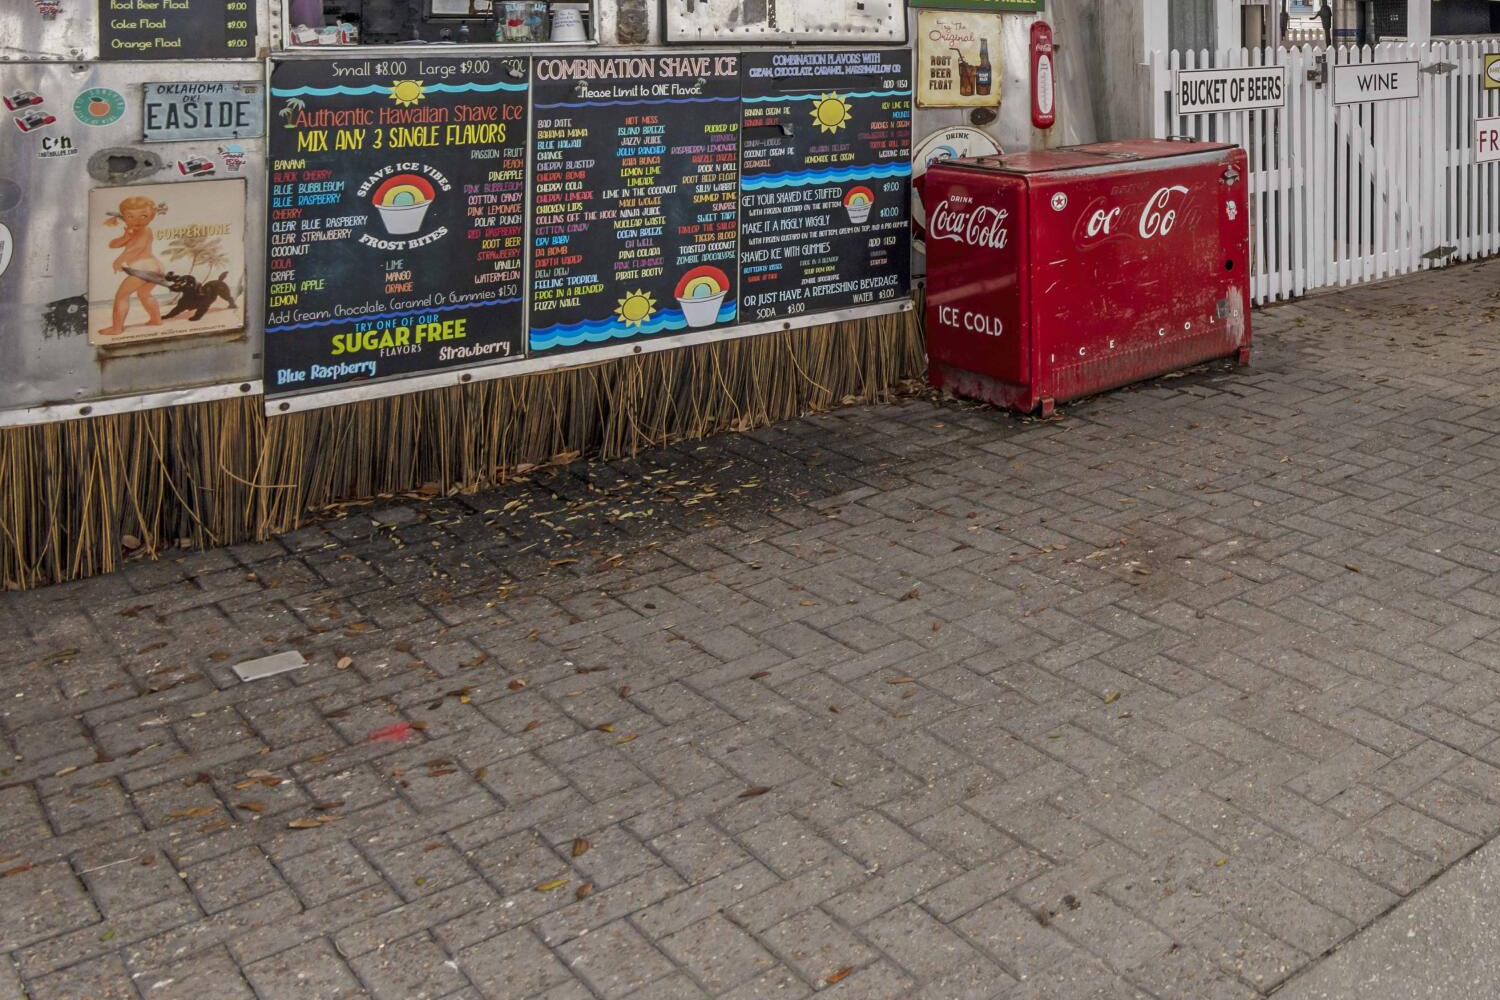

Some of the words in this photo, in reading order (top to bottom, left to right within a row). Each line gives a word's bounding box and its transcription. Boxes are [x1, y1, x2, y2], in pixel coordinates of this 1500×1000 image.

[110, 0, 133, 9] Root
[137, 0, 159, 9] Beer
[163, 0, 189, 9] Float
[227, 2, 247, 10] $9.00
[111, 19, 136, 28] Coke
[139, 19, 166, 28] Float
[227, 20, 247, 29] $9.00
[111, 39, 152, 50] Orange
[155, 38, 181, 47] Float
[227, 39, 247, 48] $9.00
[929, 30, 975, 46] Original
[772, 55, 827, 66] COMBINATION
[828, 54, 861, 65] FLAVORS
[862, 53, 880, 64] WITH
[930, 55, 952, 67] ROOT
[332, 62, 370, 77] Small
[376, 61, 406, 77] $8.00
[420, 62, 455, 78] Large
[460, 60, 490, 74] $9.00
[537, 59, 654, 80] COMBINATION
[659, 57, 711, 78] SHAVE
[714, 56, 738, 76] ICE
[930, 67, 952, 78] BEER
[157, 83, 223, 94] OKLAHOMA
[929, 79, 953, 90] FLOAT
[1357, 72, 1398, 92] WINE
[613, 85, 637, 97] Limit
[640, 87, 650, 96] to
[652, 84, 669, 96] ONE
[1182, 79, 1227, 106] BUCKET
[1230, 78, 1244, 103] OF
[1248, 76, 1281, 101] BEERS
[182, 94, 200, 103] OK!
[147, 101, 251, 130] EASIDE
[296, 108, 374, 127] Authentic
[379, 107, 448, 125] Hawaiian
[454, 104, 498, 122] Shave
[503, 104, 523, 120] Ice
[298, 130, 328, 153] MIX
[336, 129, 366, 150] ANY
[372, 128, 382, 149] 3
[389, 126, 439, 148] SINGLE
[446, 123, 506, 145] FLAVORS
[945, 132, 970, 141] DRINK
[274, 159, 305, 170] BANANA
[357, 165, 394, 197] SHAVE
[397, 162, 420, 171] ICE
[423, 164, 451, 192] VIBES
[488, 170, 523, 181] PINEAPPLE
[883, 181, 899, 192] $9.00
[741, 195, 755, 207] GET
[757, 193, 775, 205] YOUR
[776, 190, 801, 204] SHAVED
[803, 189, 813, 200] ICE
[814, 187, 842, 200] STUFFED
[950, 195, 973, 204] DRINK
[880, 207, 899, 217] $10.00
[272, 221, 296, 232] CLEAR
[301, 219, 321, 230] BLUE
[326, 215, 368, 228] RASPBERRY
[930, 199, 1009, 249] Coca-Cola
[155, 223, 232, 240] COPPERTONE
[272, 233, 296, 245] CLEAR
[301, 229, 353, 242] STRAWBERRY
[358, 233, 406, 250] FROST
[409, 226, 448, 249] BITES
[482, 239, 501, 249] ROOT
[505, 237, 521, 247] BEER
[272, 244, 310, 257] COCONUT
[741, 250, 769, 263] SHAVED
[771, 248, 782, 259] ICE
[784, 246, 800, 258] WITH
[801, 242, 831, 255] GUMMIES
[494, 260, 521, 270] VANILLA
[271, 270, 295, 281] GRAPE
[474, 271, 520, 284] WATERMELON
[271, 282, 296, 293] GREEN
[301, 279, 325, 291] APPLE
[744, 295, 757, 307] OR
[758, 292, 778, 306] JUST
[779, 289, 801, 302] HAVE
[804, 286, 811, 297] A
[812, 281, 858, 296] REFRESHING
[860, 274, 898, 289] BEVERAGE
[270, 294, 298, 307] LEMON
[853, 291, 873, 304] WATER
[879, 289, 895, 300] $3.00
[268, 312, 290, 325] Add
[390, 297, 432, 310] Caramel
[435, 293, 447, 304] Or
[450, 290, 496, 304] Gummies
[757, 307, 776, 319] SODA
[787, 302, 805, 314] $3.00
[355, 322, 372, 332] TRY
[377, 320, 397, 330] ONE
[401, 317, 415, 326] OF
[418, 314, 439, 324] OUR
[939, 305, 960, 328] ICE
[964, 311, 1003, 336] COLD
[330, 326, 410, 355] SUGAR
[415, 319, 467, 343] FREE
[380, 344, 422, 358] FLAVORS
[439, 341, 510, 361] Strawberry
[277, 368, 305, 385] Blue
[310, 360, 376, 380] Raspberry
